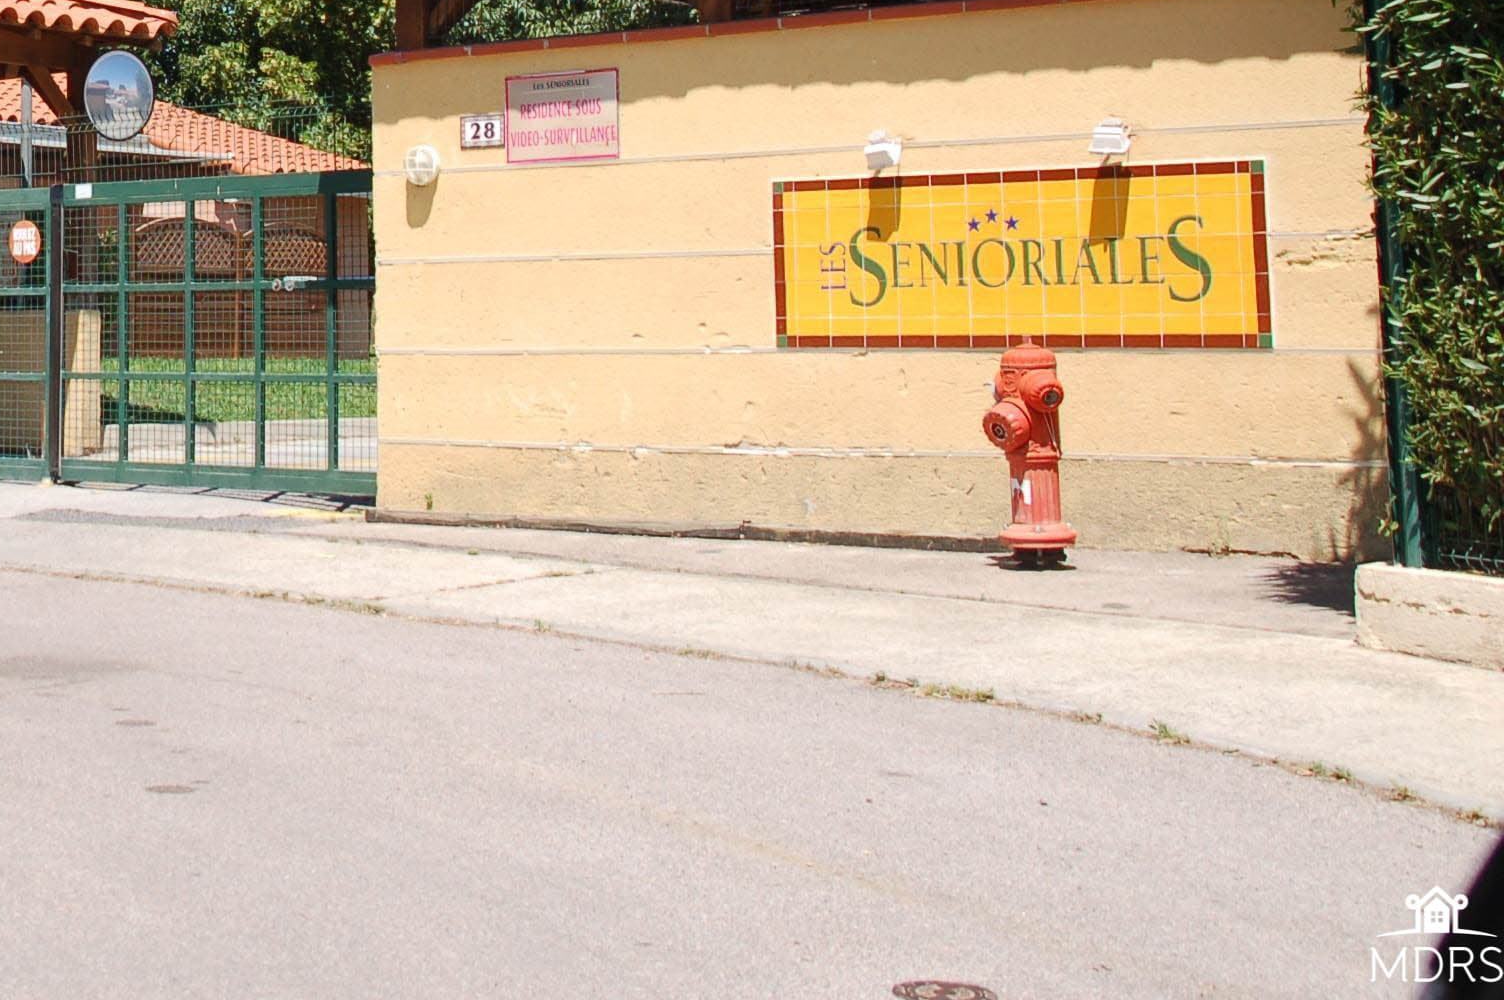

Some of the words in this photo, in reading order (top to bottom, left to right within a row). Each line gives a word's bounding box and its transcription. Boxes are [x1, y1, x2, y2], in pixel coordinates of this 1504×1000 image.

[576, 98, 601, 116] SOUS
[470, 122, 495, 140] 28
[819, 242, 846, 290] LES
[849, 215, 1213, 307] SENIORIALES
